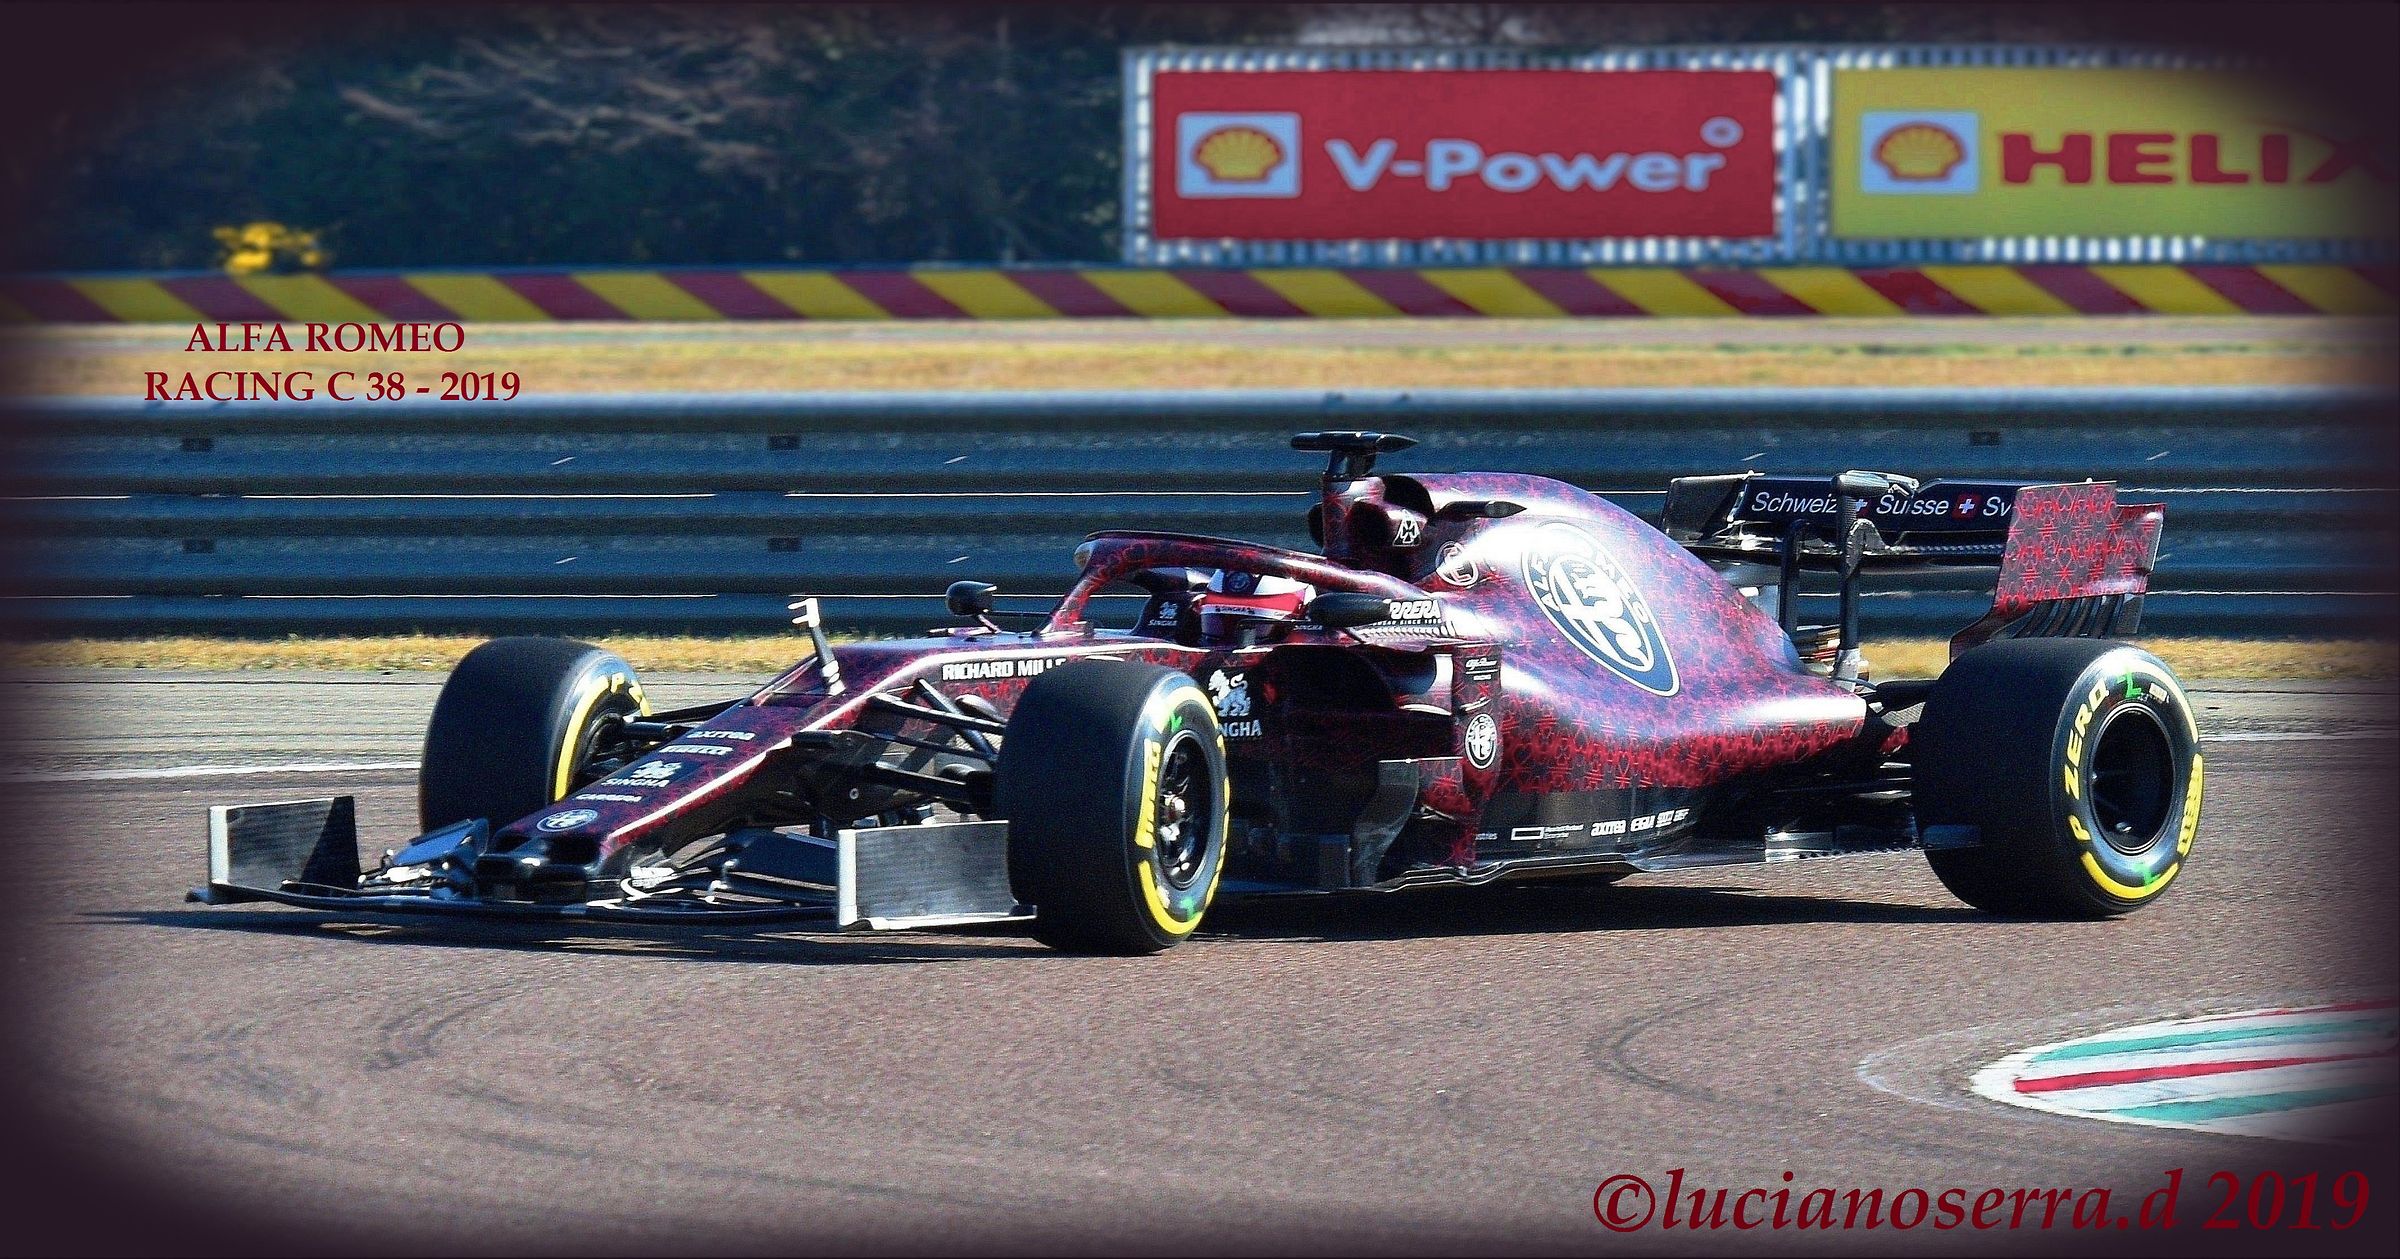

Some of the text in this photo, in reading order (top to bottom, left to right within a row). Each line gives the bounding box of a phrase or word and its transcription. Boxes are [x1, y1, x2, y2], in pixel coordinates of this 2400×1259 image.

[1324, 138, 1725, 192] V-Power
[1751, 491, 1838, 514] Schweiz
[942, 660, 1014, 681] RICHARD
[1217, 719, 1263, 738] NGHA
[600, 778, 670, 788] SINGHA
